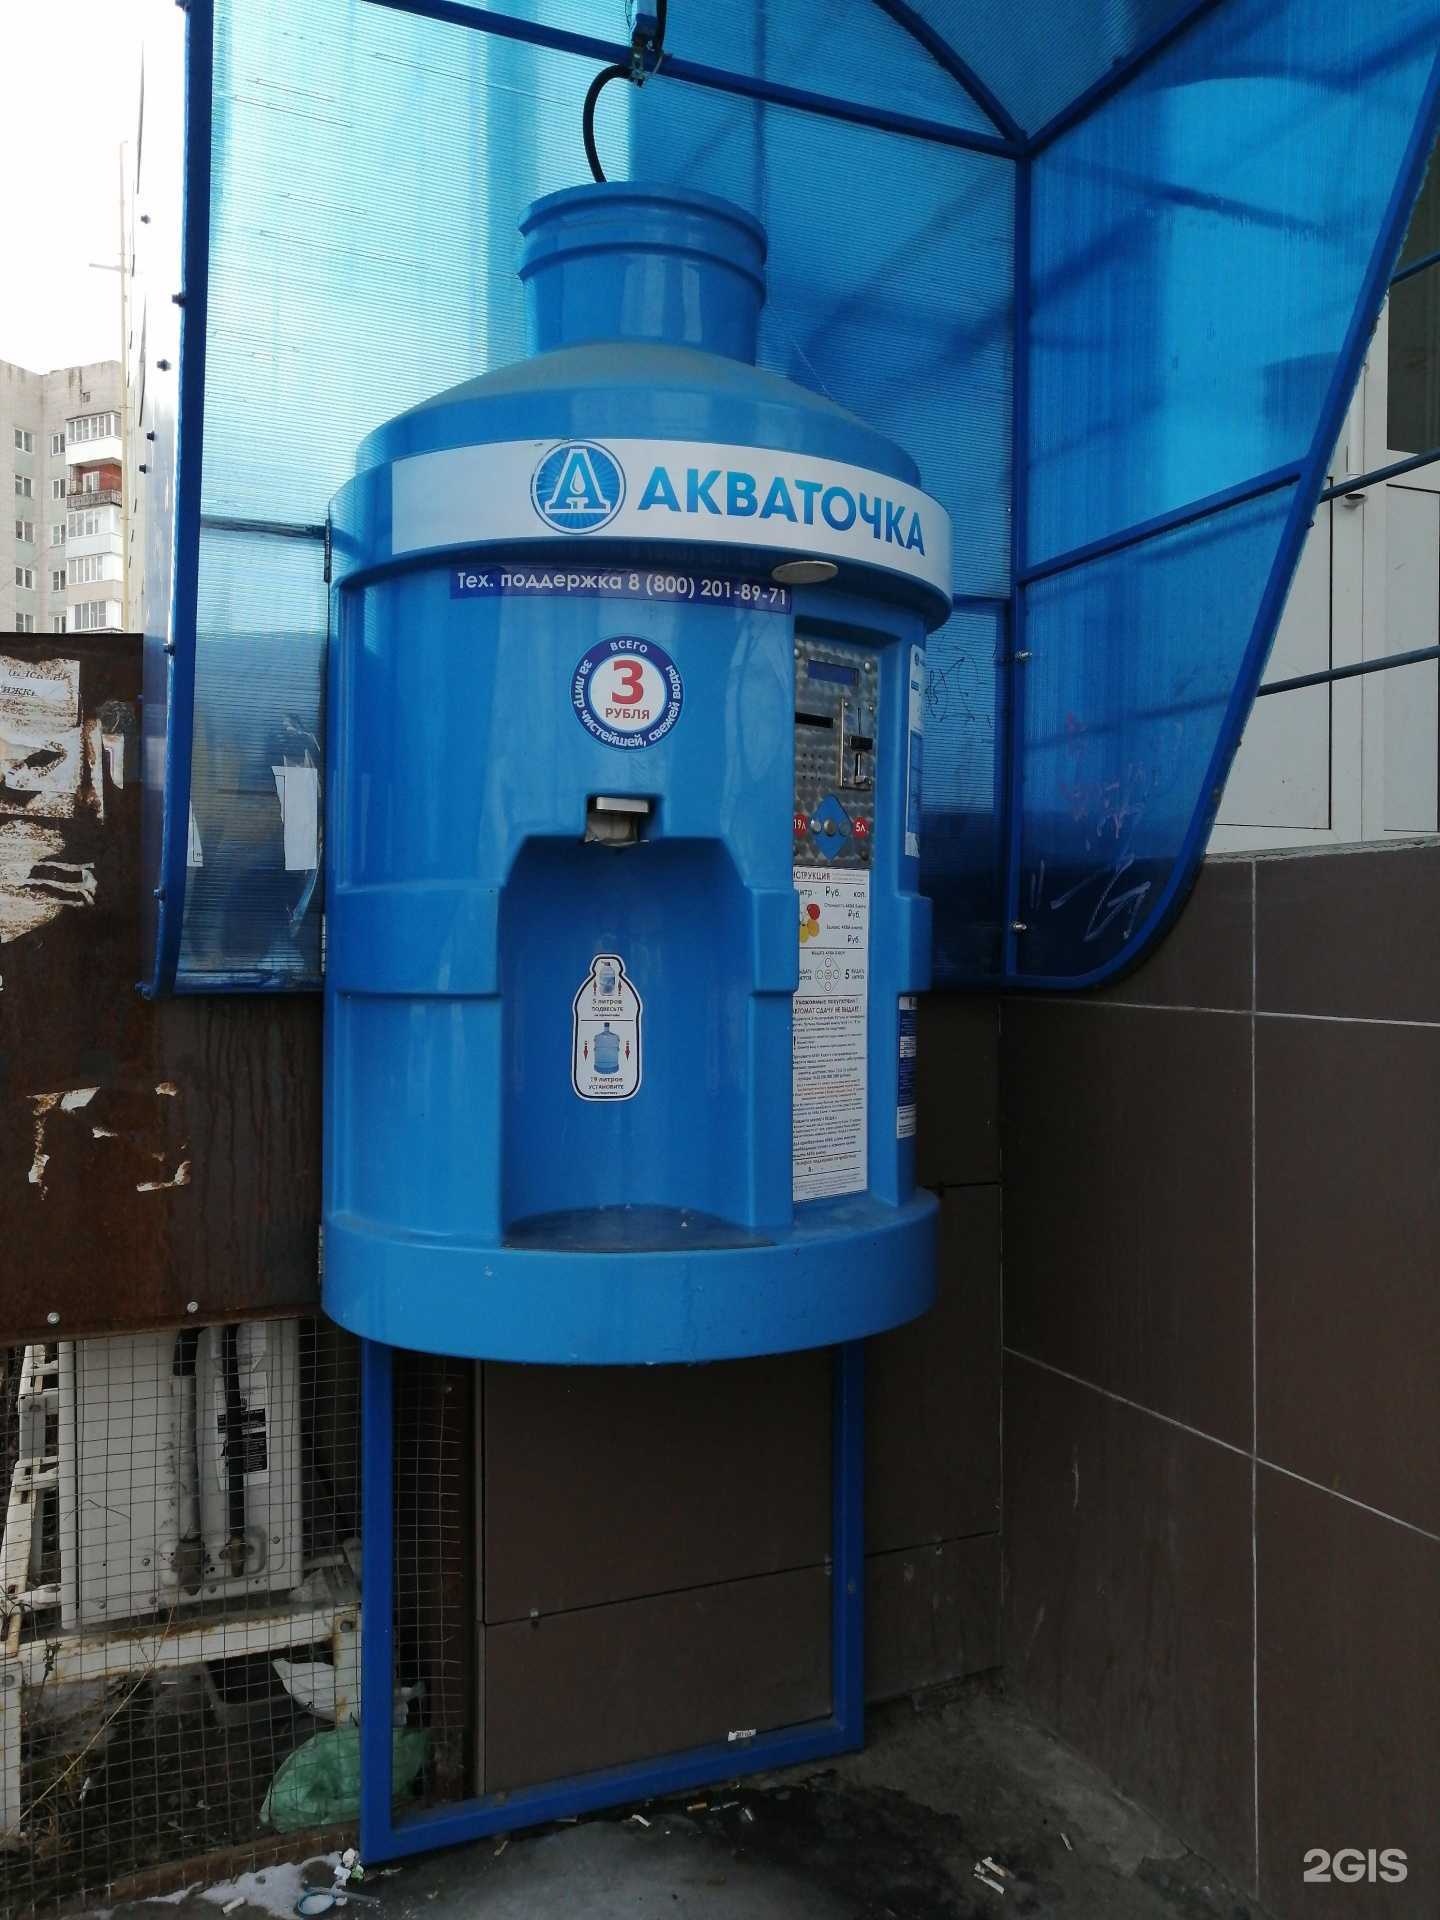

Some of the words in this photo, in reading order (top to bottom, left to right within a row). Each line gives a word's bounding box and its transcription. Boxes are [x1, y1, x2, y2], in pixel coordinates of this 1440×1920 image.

[637, 466, 926, 556] АКВАТОЧКА
[457, 572, 494, 589] Тех.
[501, 573, 622, 592] поддержка
[628, 573, 640, 591] 8
[646, 574, 695, 599] (800)
[701, 579, 786, 605] 201-89-71
[609, 640, 648, 653] ВСЕГО
[579, 660, 592, 675] за
[611, 659, 644, 705] 3
[665, 665, 681, 700] воды
[573, 676, 585, 708] литр
[581, 709, 647, 748] чистейшей,
[605, 707, 650, 720] РУБЛЯ
[648, 702, 681, 741] свежей
[845, 968, 850, 980] 5
